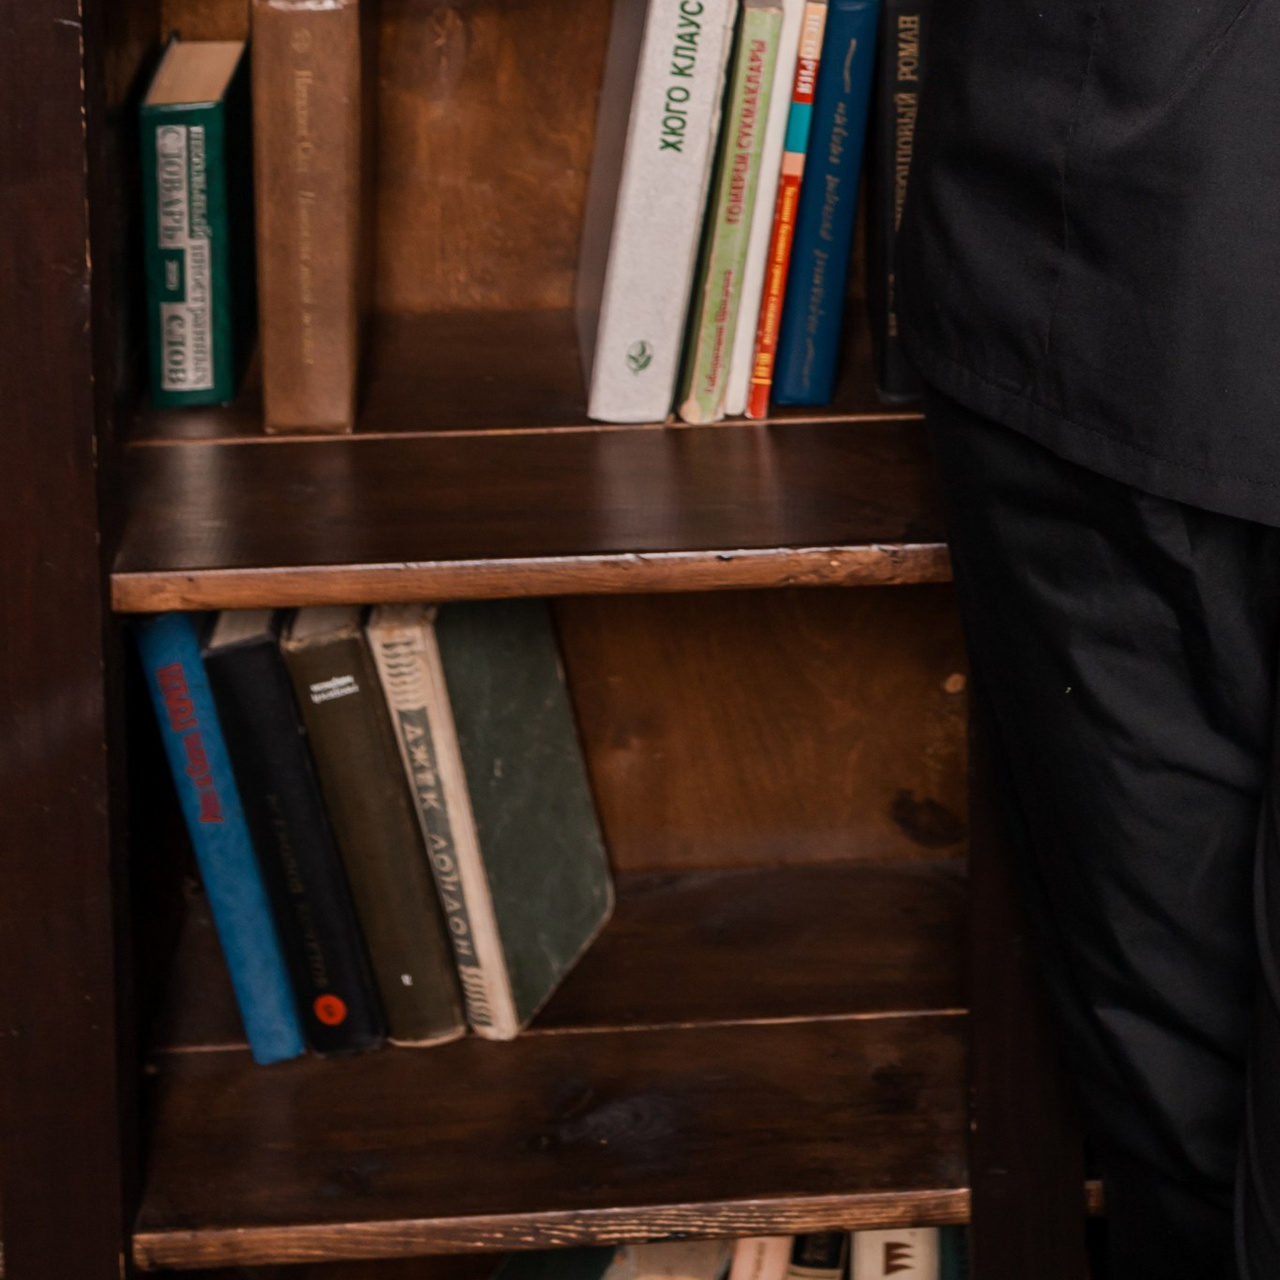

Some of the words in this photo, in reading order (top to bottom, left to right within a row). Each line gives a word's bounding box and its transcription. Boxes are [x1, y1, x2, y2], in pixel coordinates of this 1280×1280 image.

[897, 14, 920, 83] РОМАН
[659, 86, 692, 153] ХЮГО
[157, 127, 184, 244] СЛОВАРЬ
[164, 312, 185, 386] СЛОВ
[403, 722, 440, 813] ДЖЕК
[428, 832, 474, 957] ЛОНДОН
